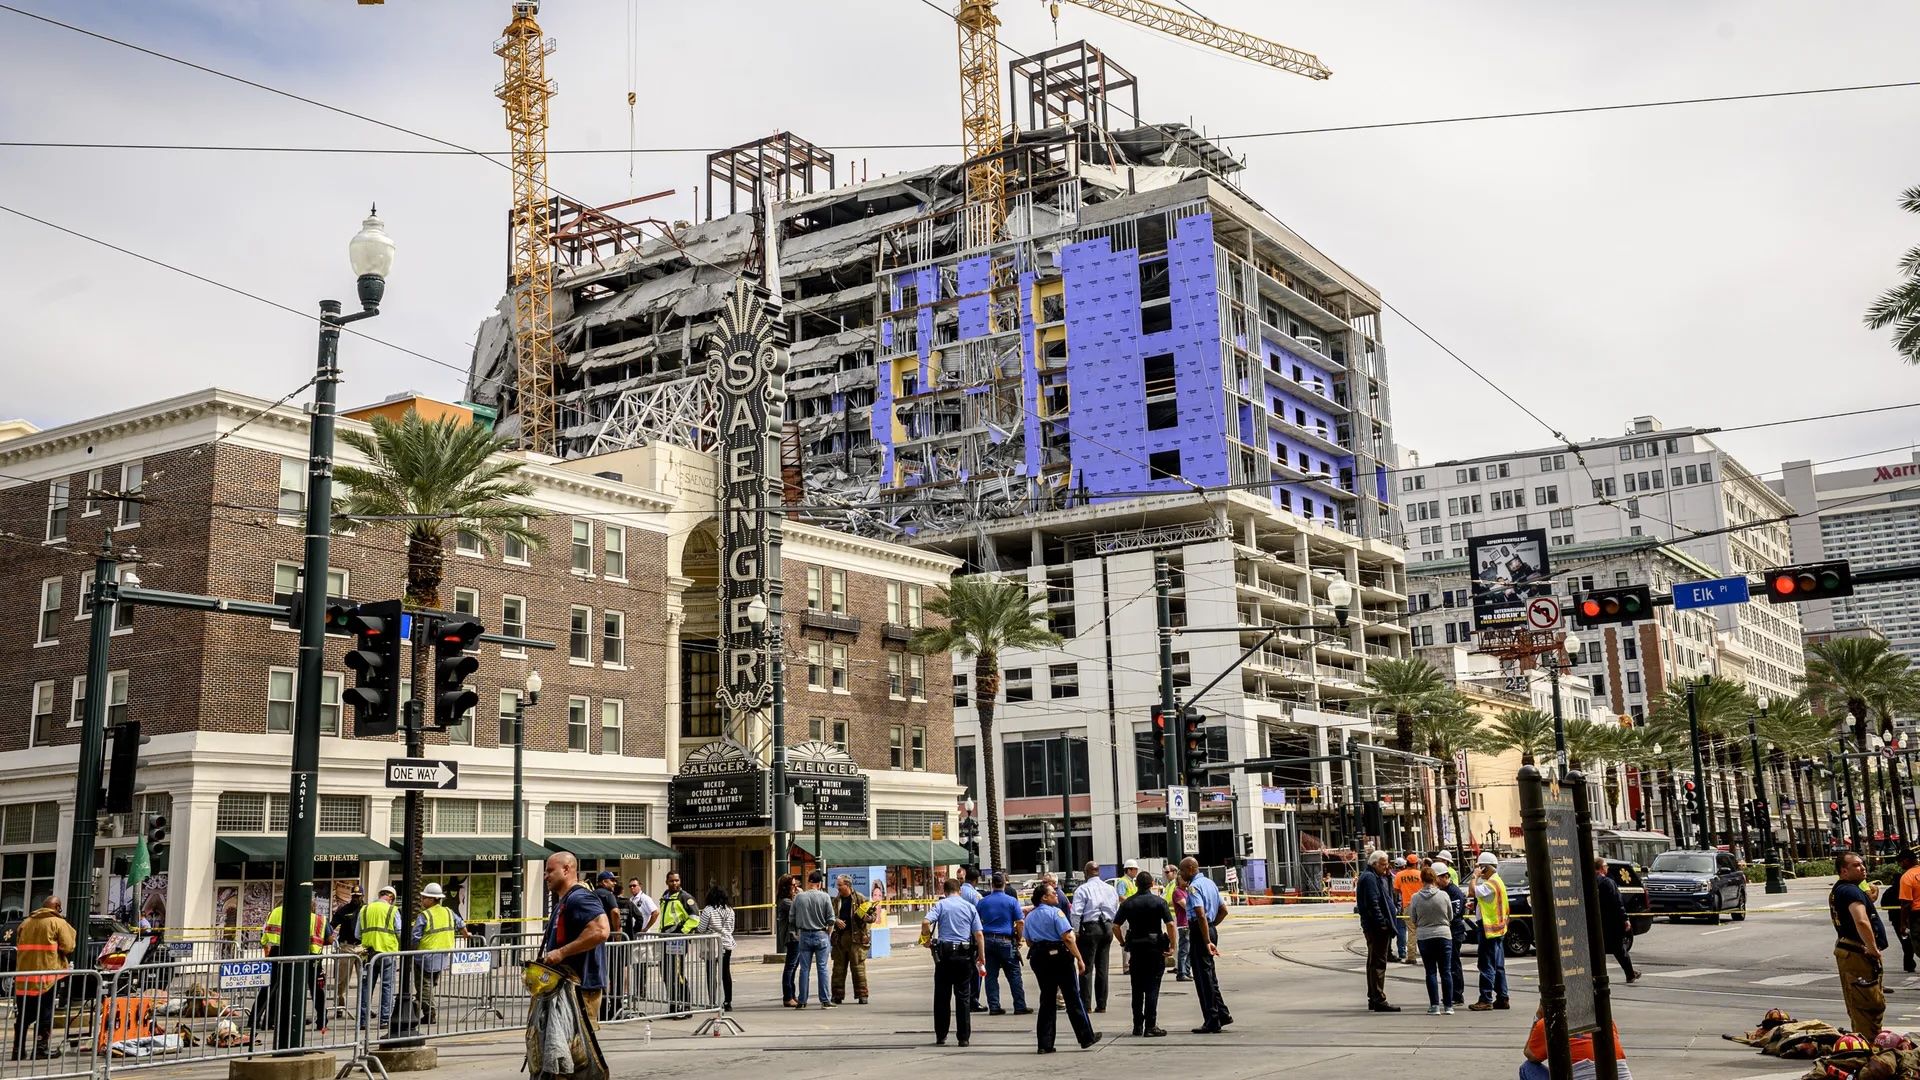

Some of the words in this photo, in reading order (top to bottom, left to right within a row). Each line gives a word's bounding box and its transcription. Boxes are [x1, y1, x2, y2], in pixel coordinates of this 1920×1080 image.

[1873, 464, 1920, 482] Marr
[727, 350, 758, 686] SAENGER
[1692, 587, 1715, 602] Elk
[1719, 585, 1728, 593] Pl
[393, 767, 414, 780] ONE
[417, 767, 437, 780] WAY
[681, 761, 745, 775] SAENGER
[784, 761, 857, 775] SAENGER
[703, 780, 726, 788] WICKED
[822, 780, 842, 788] WHITNEY
[1457, 753, 1468, 806] ainbow
[691, 789, 718, 798] OCTOBER
[719, 788, 724, 796] 2
[730, 787, 738, 795] 20
[831, 788, 851, 796] ORLEANS
[686, 797, 713, 806] HANCOCK
[716, 795, 743, 804] WHITNEY
[698, 804, 731, 813] BROADWAY
[1184, 824, 1197, 832] GREEN
[1184, 833, 1198, 841] ARROW
[1185, 842, 1197, 850] ONLY
[1400, 875, 1420, 883] RMS
